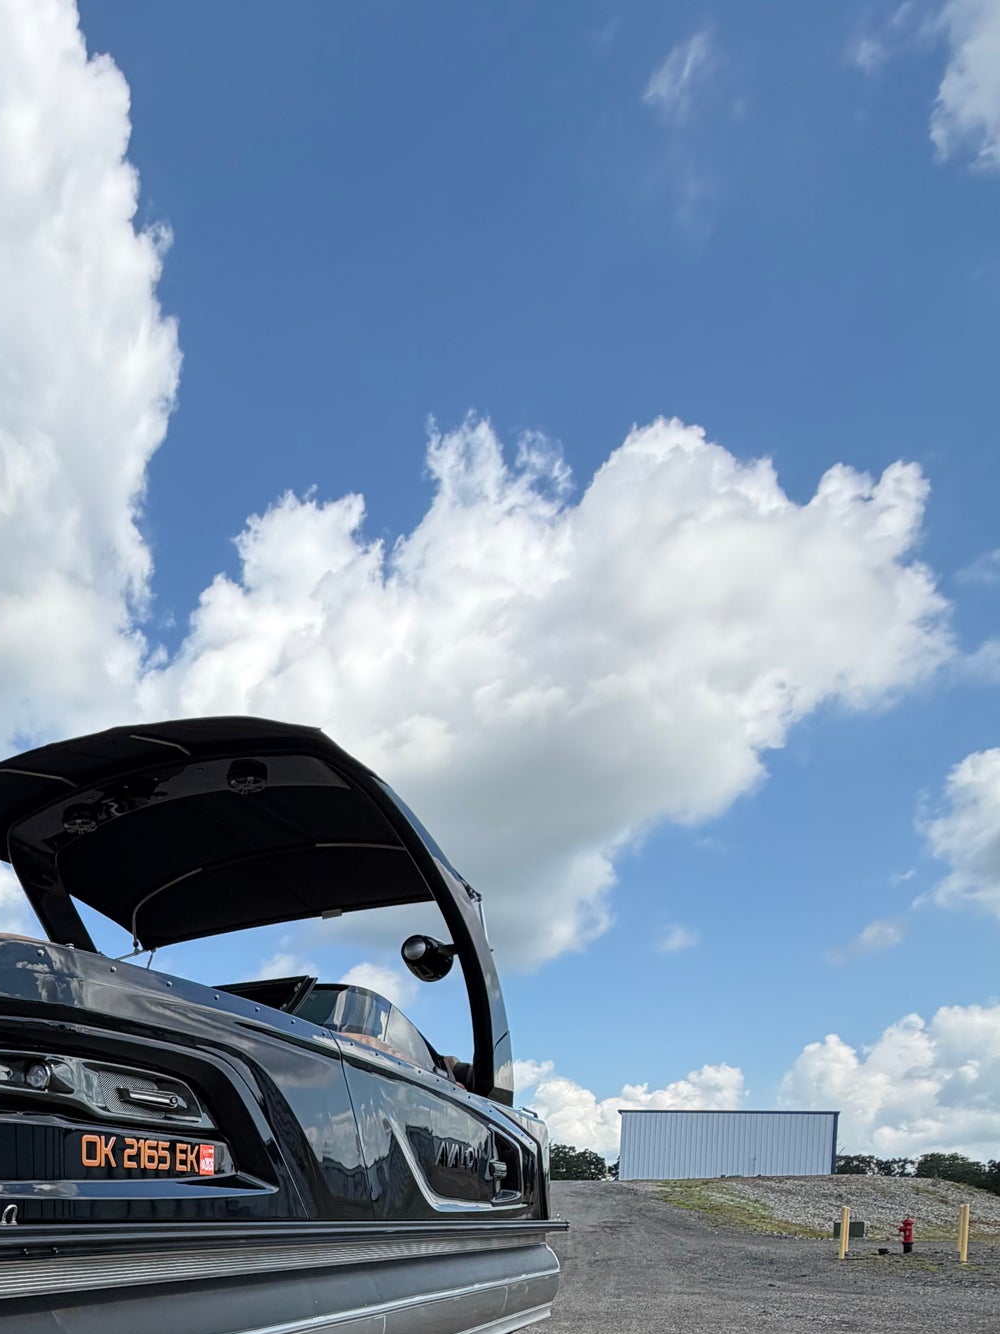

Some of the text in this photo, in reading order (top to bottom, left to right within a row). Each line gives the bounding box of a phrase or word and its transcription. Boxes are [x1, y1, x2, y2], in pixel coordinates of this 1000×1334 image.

[81, 1134, 117, 1168] OK
[123, 1137, 170, 1171] 2165
[175, 1142, 199, 1173] EK
[434, 1140, 482, 1171] AVALON
